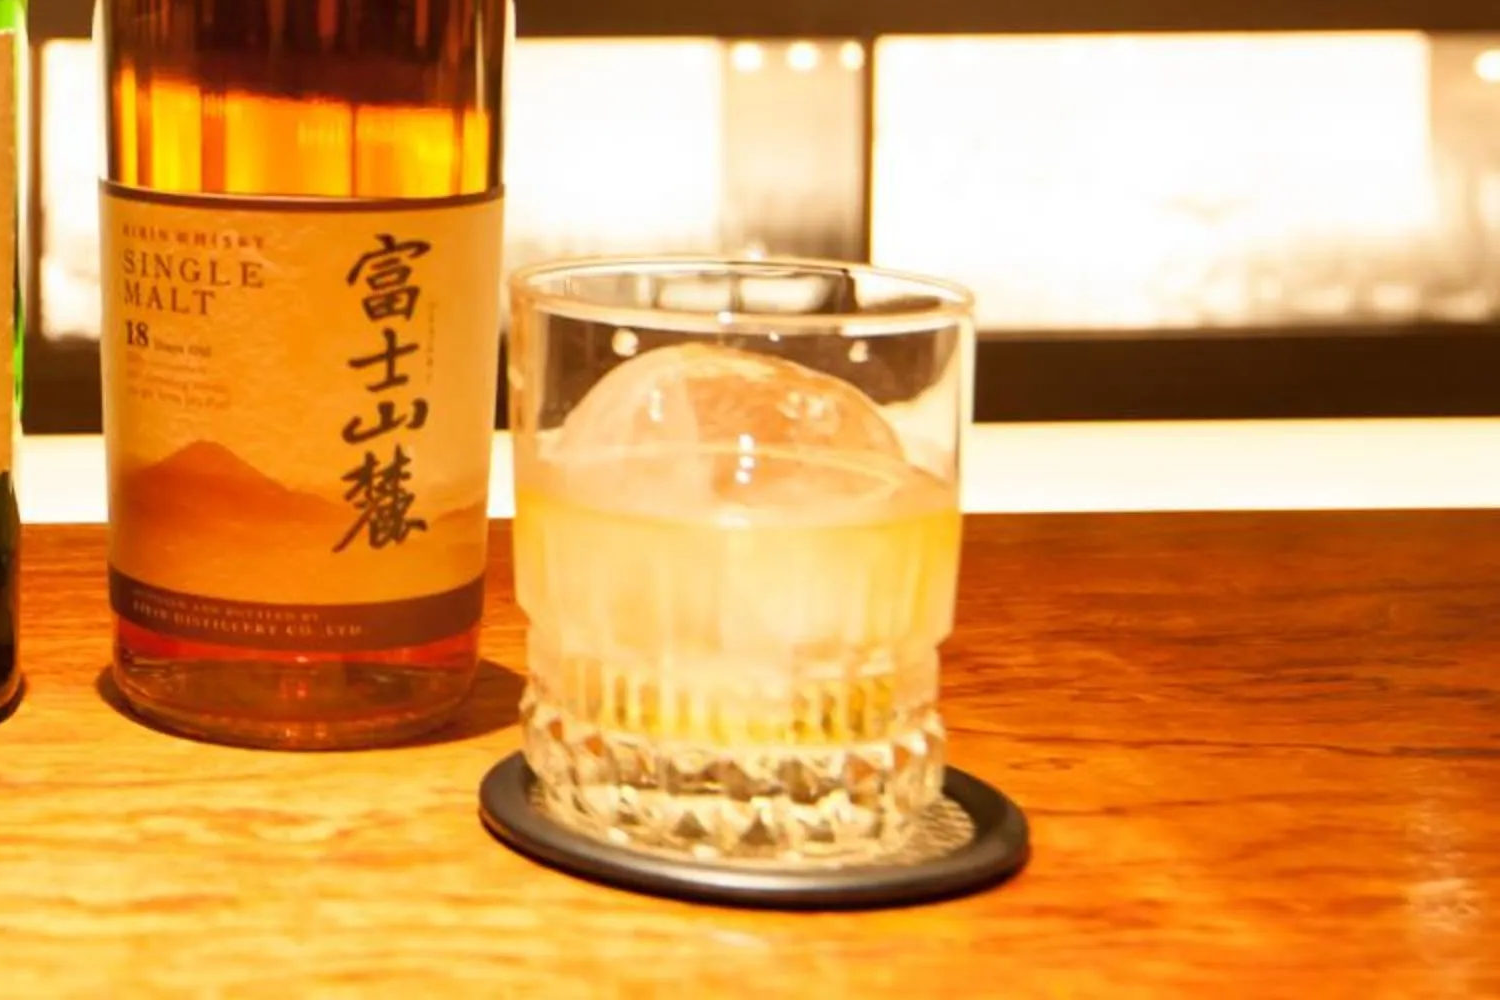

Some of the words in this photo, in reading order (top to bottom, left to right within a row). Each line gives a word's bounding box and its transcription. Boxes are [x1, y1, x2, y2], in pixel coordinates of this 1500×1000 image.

[122, 248, 265, 290] SINGLE
[123, 279, 217, 317] MALT
[124, 319, 151, 348] 18
[331, 233, 436, 554] 富士山麓
